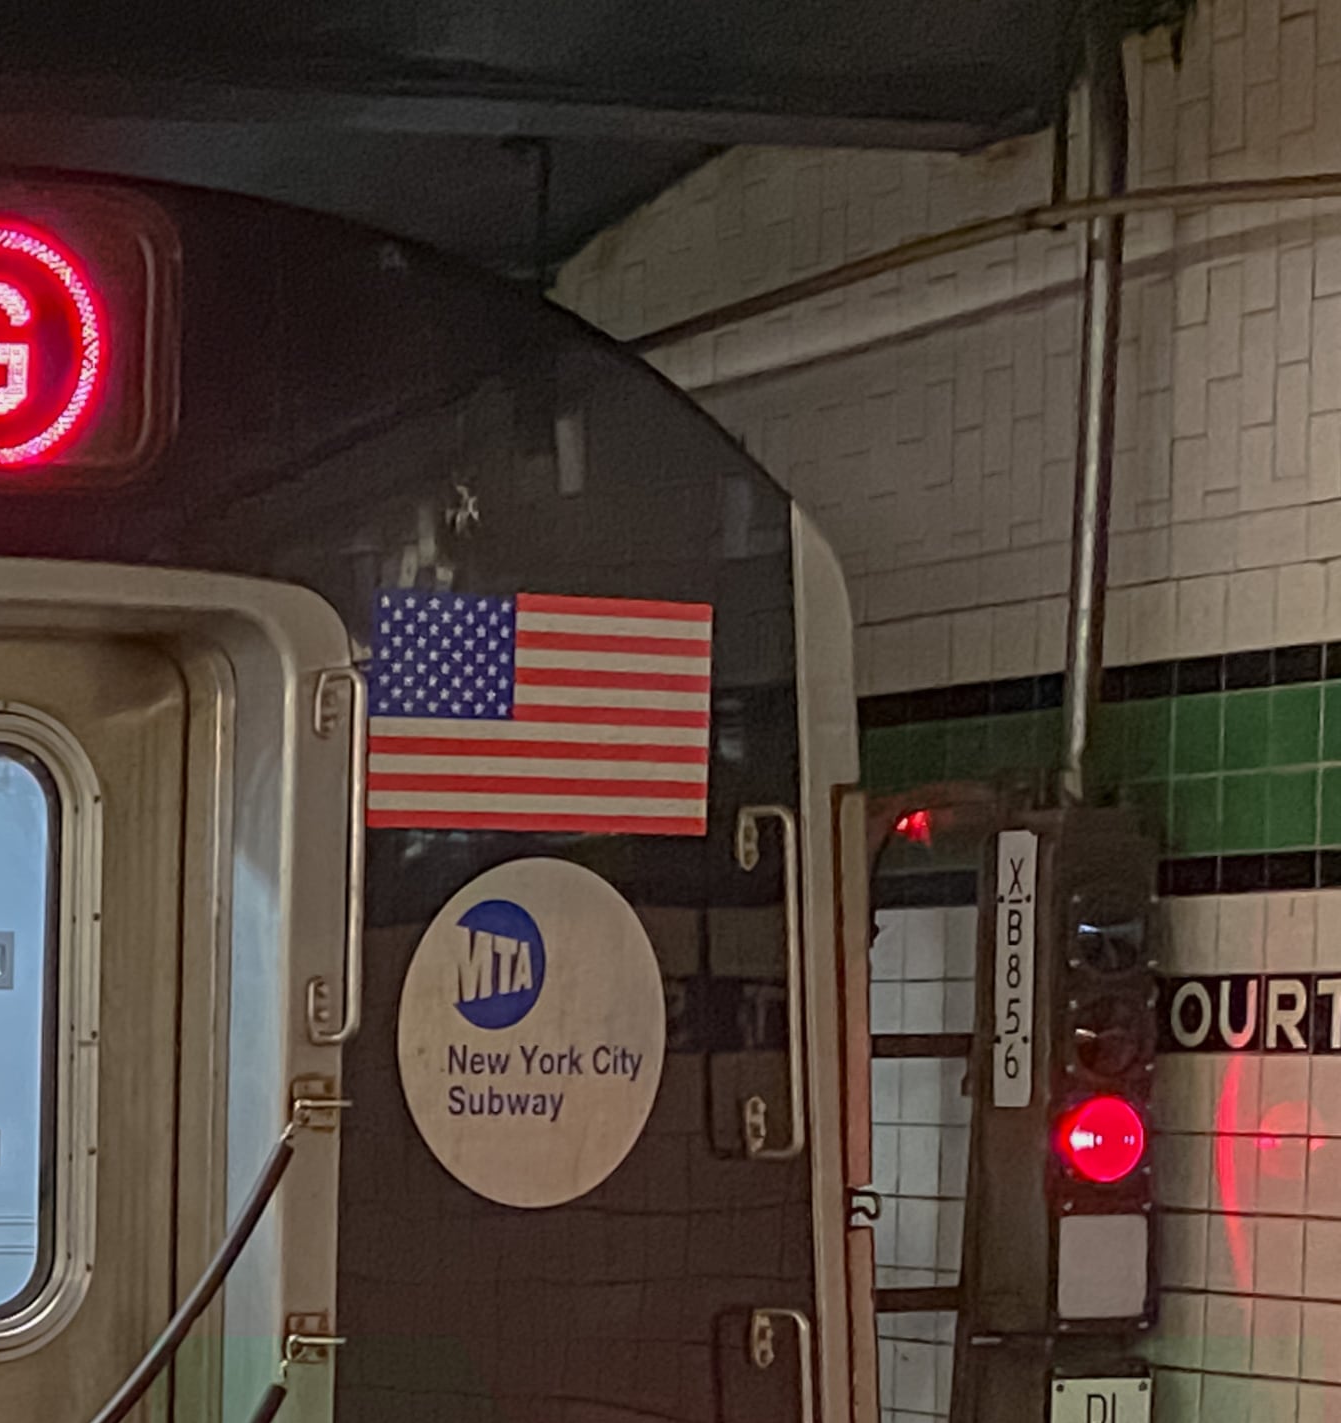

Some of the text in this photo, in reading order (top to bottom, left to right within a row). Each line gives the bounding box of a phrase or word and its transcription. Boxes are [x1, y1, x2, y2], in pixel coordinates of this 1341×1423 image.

[455, 923, 534, 1004] MTA
[1170, 979, 1341, 1049] OURT
[448, 1044, 643, 1082] New York City
[448, 1085, 564, 1123] Subway
